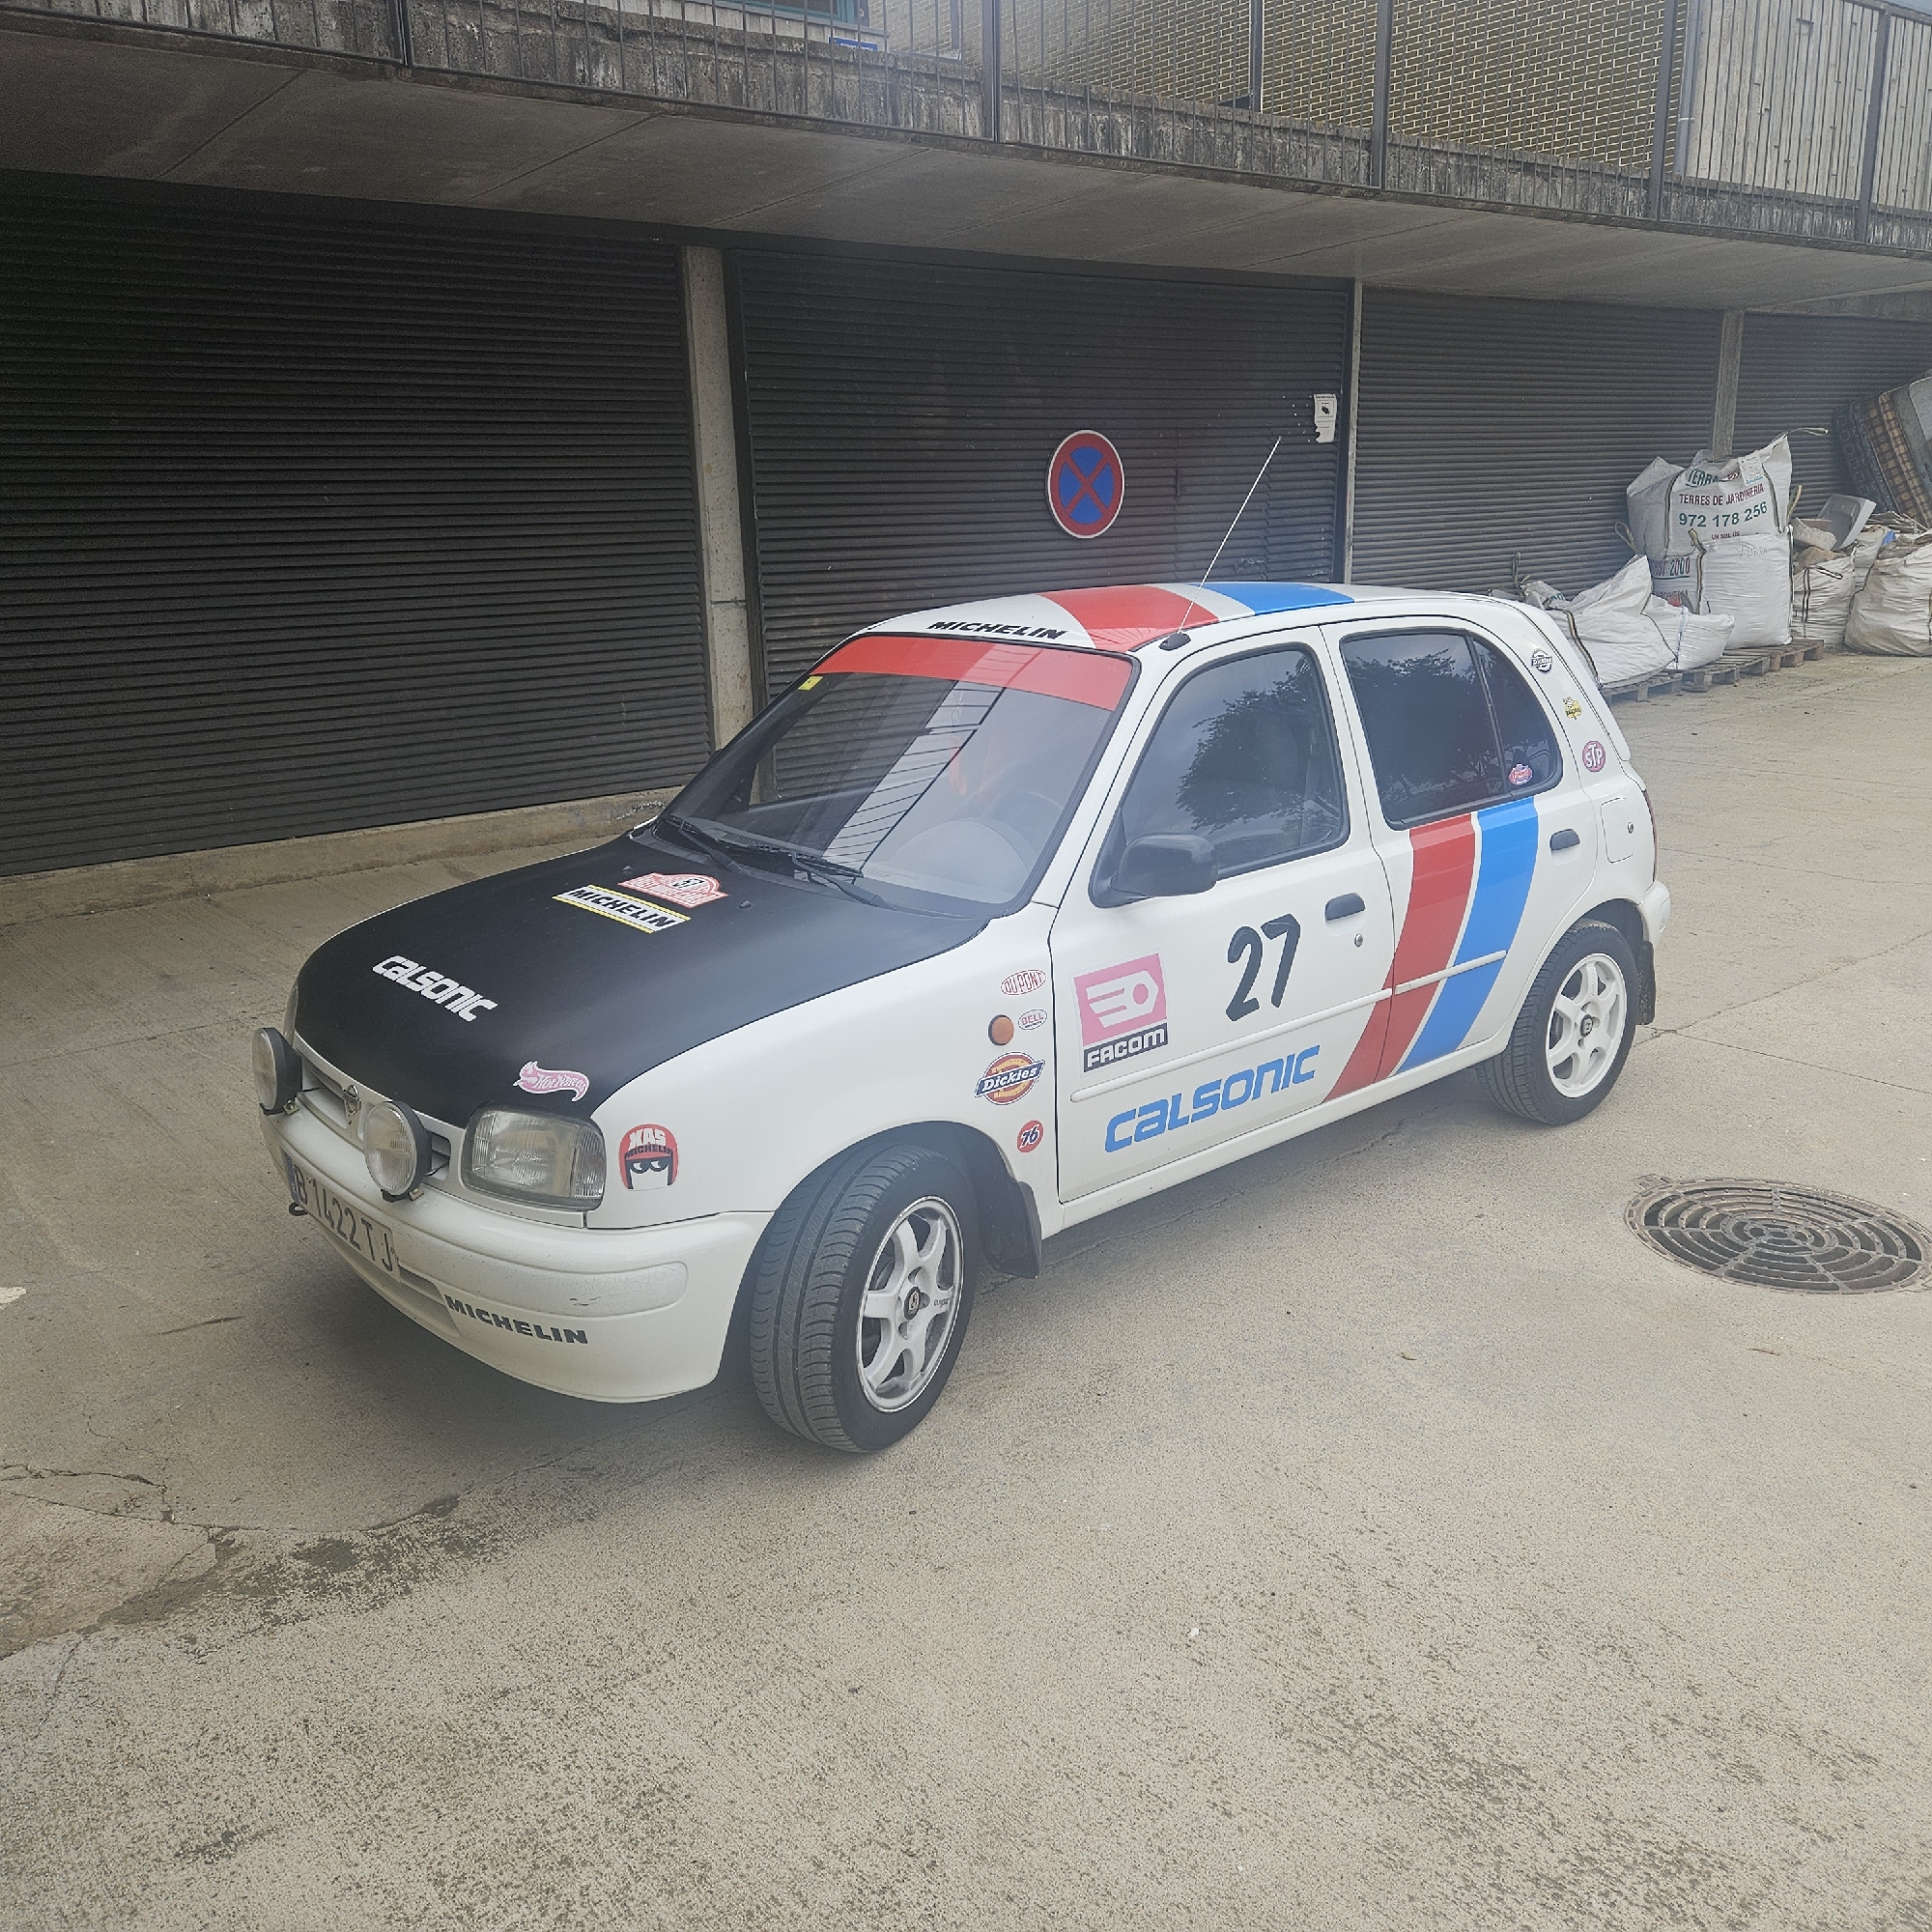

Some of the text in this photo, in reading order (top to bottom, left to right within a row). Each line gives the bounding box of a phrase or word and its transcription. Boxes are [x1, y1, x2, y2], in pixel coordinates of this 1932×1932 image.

[1679, 483, 1764, 506] TERRES DE JARDINERIA
[1679, 501, 1768, 527] 972 178 256
[1670, 556, 1690, 576] 2000
[927, 621, 1066, 640] MICHELIN
[1585, 743, 1604, 769] STP
[568, 890, 676, 927] MICHELIN
[1225, 913, 1301, 1021] 27
[1021, 1012, 1043, 1026] BELL
[1087, 1027, 1166, 1068] FACOM
[981, 1066, 1037, 1093] Dickies
[628, 1127, 667, 1151] XAS
[1020, 1126, 1040, 1148] 76
[624, 1143, 673, 1159] MICHELIN
[444, 1293, 589, 1346] MICHELIN
